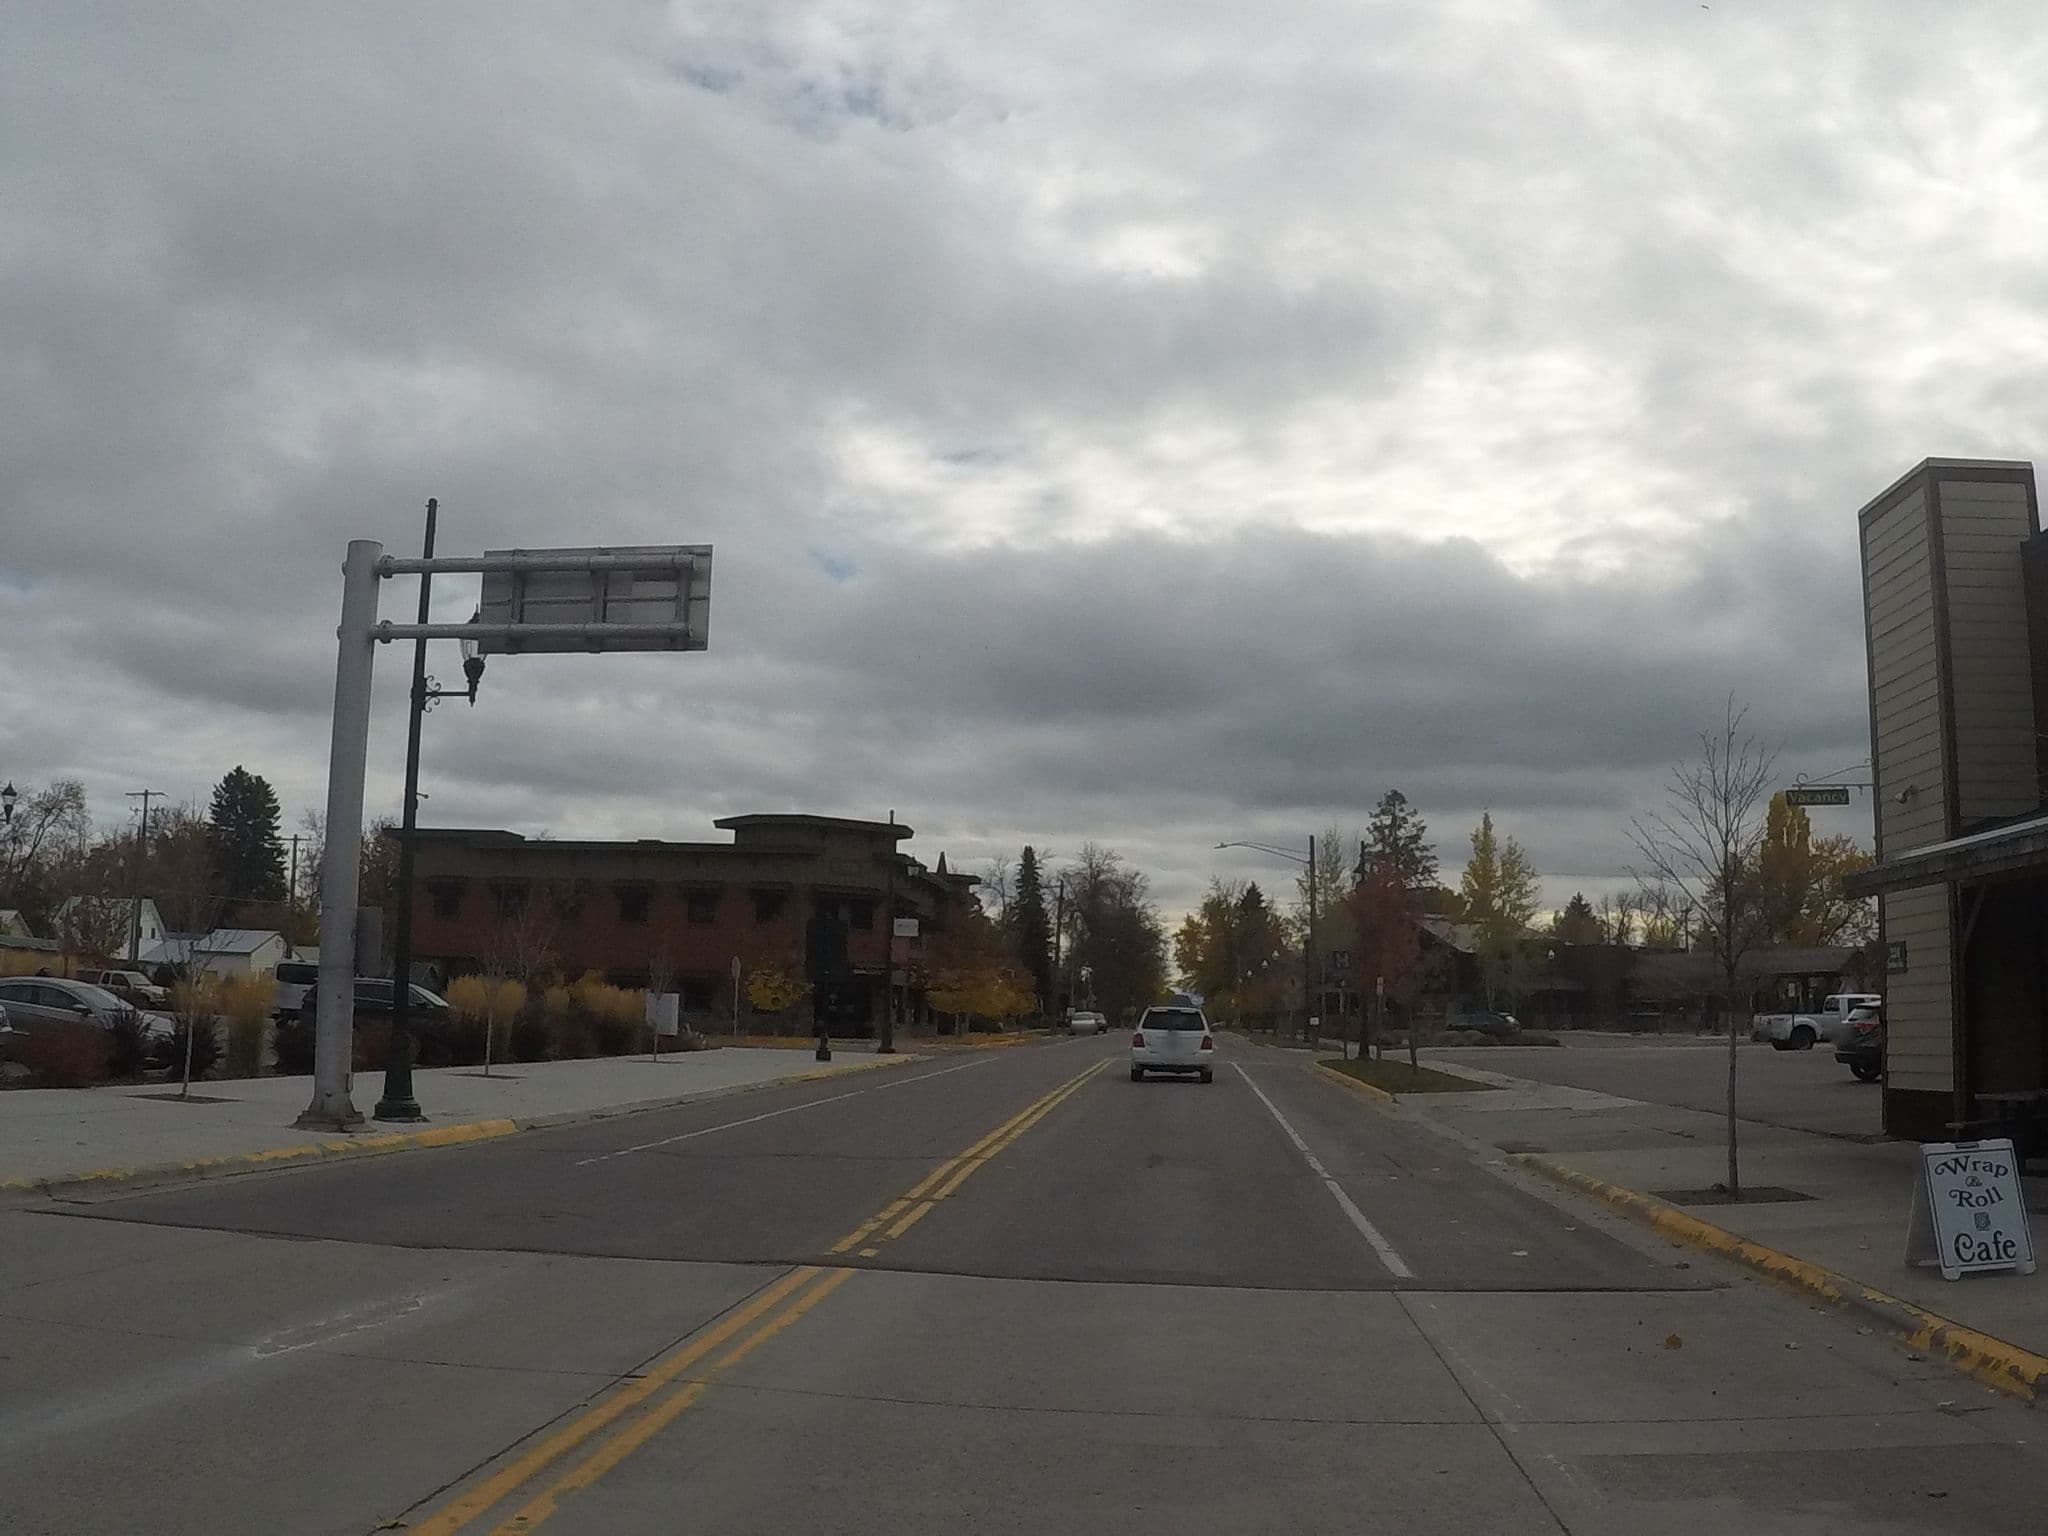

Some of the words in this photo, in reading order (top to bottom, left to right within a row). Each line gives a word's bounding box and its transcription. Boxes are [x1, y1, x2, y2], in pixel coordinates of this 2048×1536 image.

[1935, 1156, 2008, 1178] Wrap
[1949, 1187, 2004, 1208] Roll
[1954, 1230, 2017, 1263] Cafe
